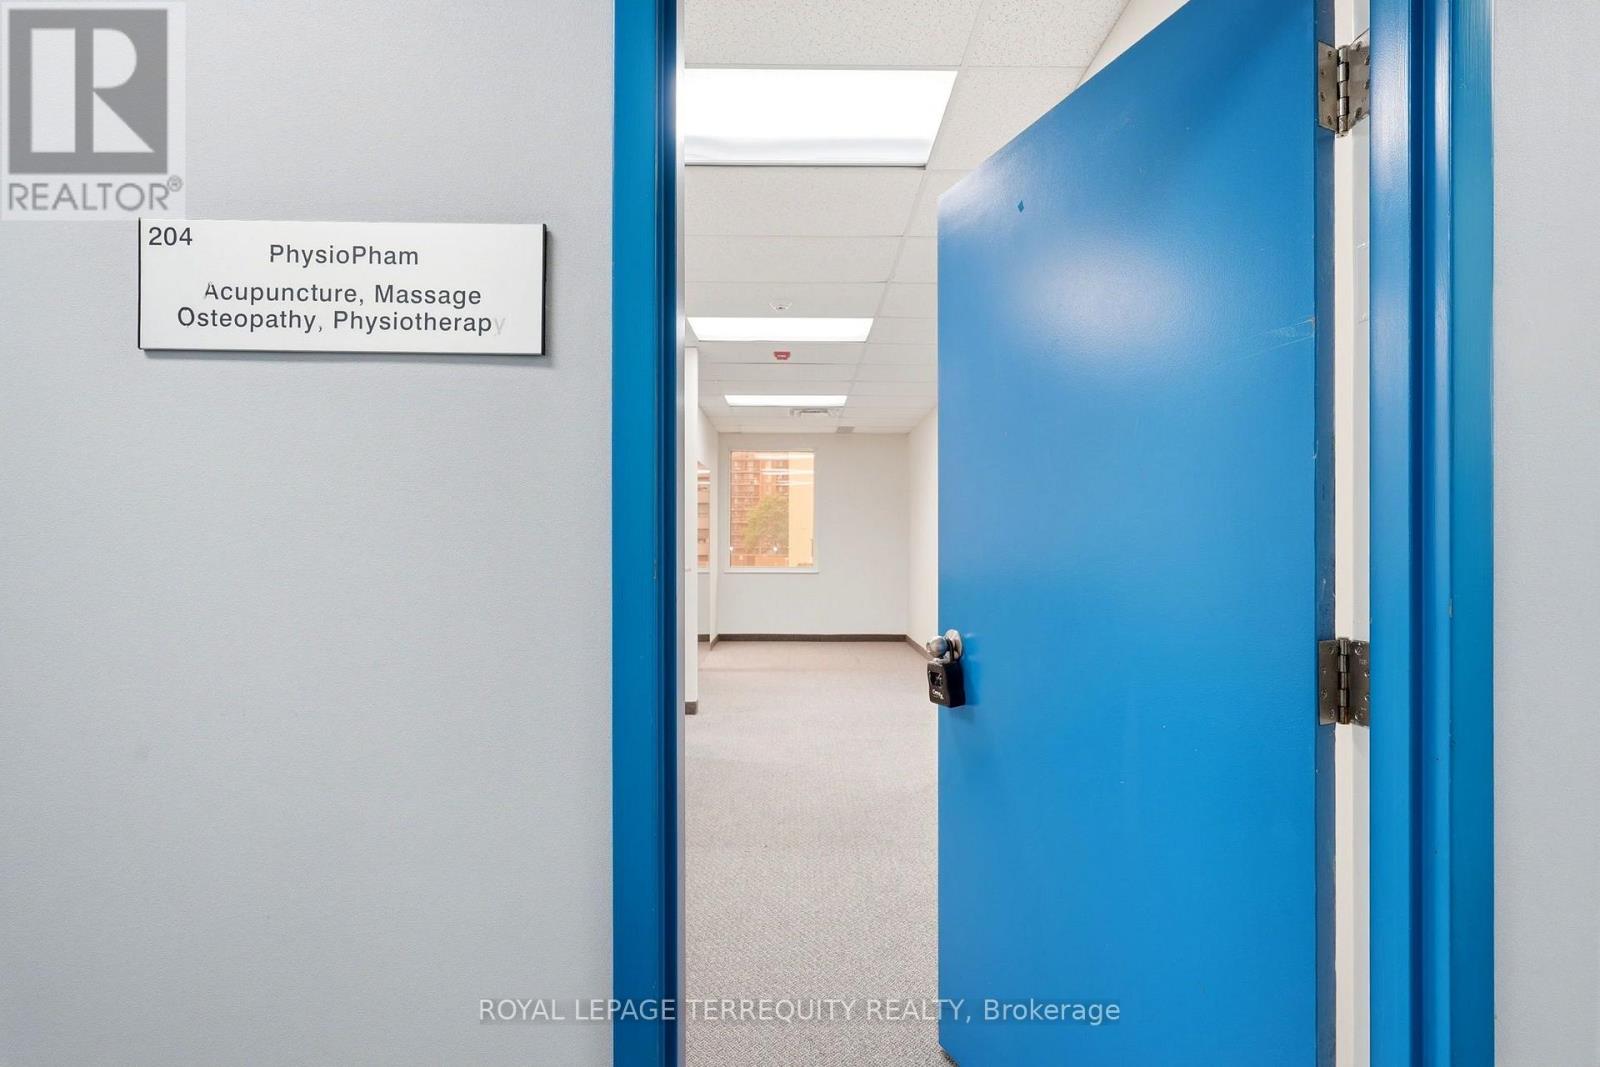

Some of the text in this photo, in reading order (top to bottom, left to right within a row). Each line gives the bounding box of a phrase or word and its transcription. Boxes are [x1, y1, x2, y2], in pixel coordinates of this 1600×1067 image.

[148, 226, 193, 247] 204
[269, 244, 420, 269] PhysioPham
[204, 281, 482, 309] Acupuncture, Massage
[177, 306, 323, 333] Osteopathy,
